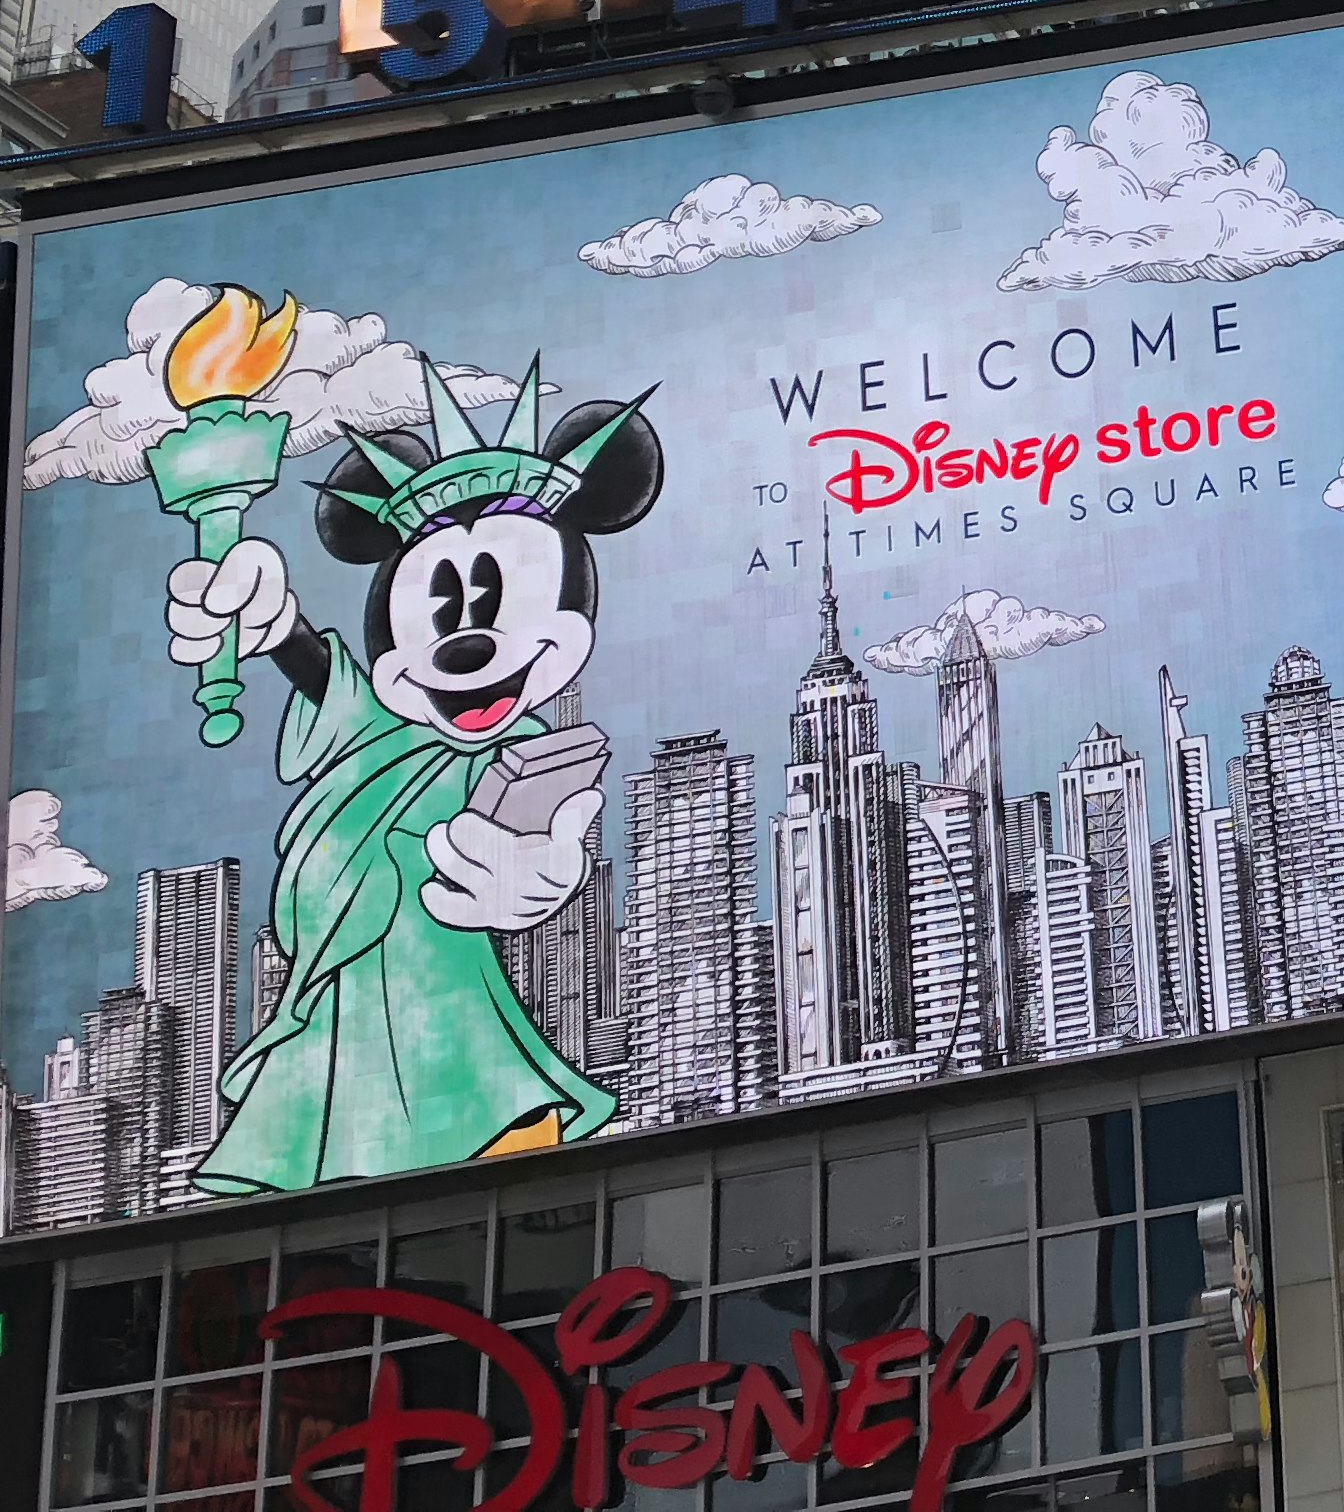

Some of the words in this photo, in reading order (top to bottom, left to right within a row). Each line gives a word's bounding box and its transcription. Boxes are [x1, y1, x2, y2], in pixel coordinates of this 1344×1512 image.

[770, 302, 1241, 425] WELCOME
[753, 481, 788, 507] TO
[807, 420, 1080, 514] Disney
[1095, 397, 1278, 464] store
[747, 538, 803, 575] AT
[848, 504, 1018, 558] TIMES
[1069, 457, 1297, 522] SQUARE
